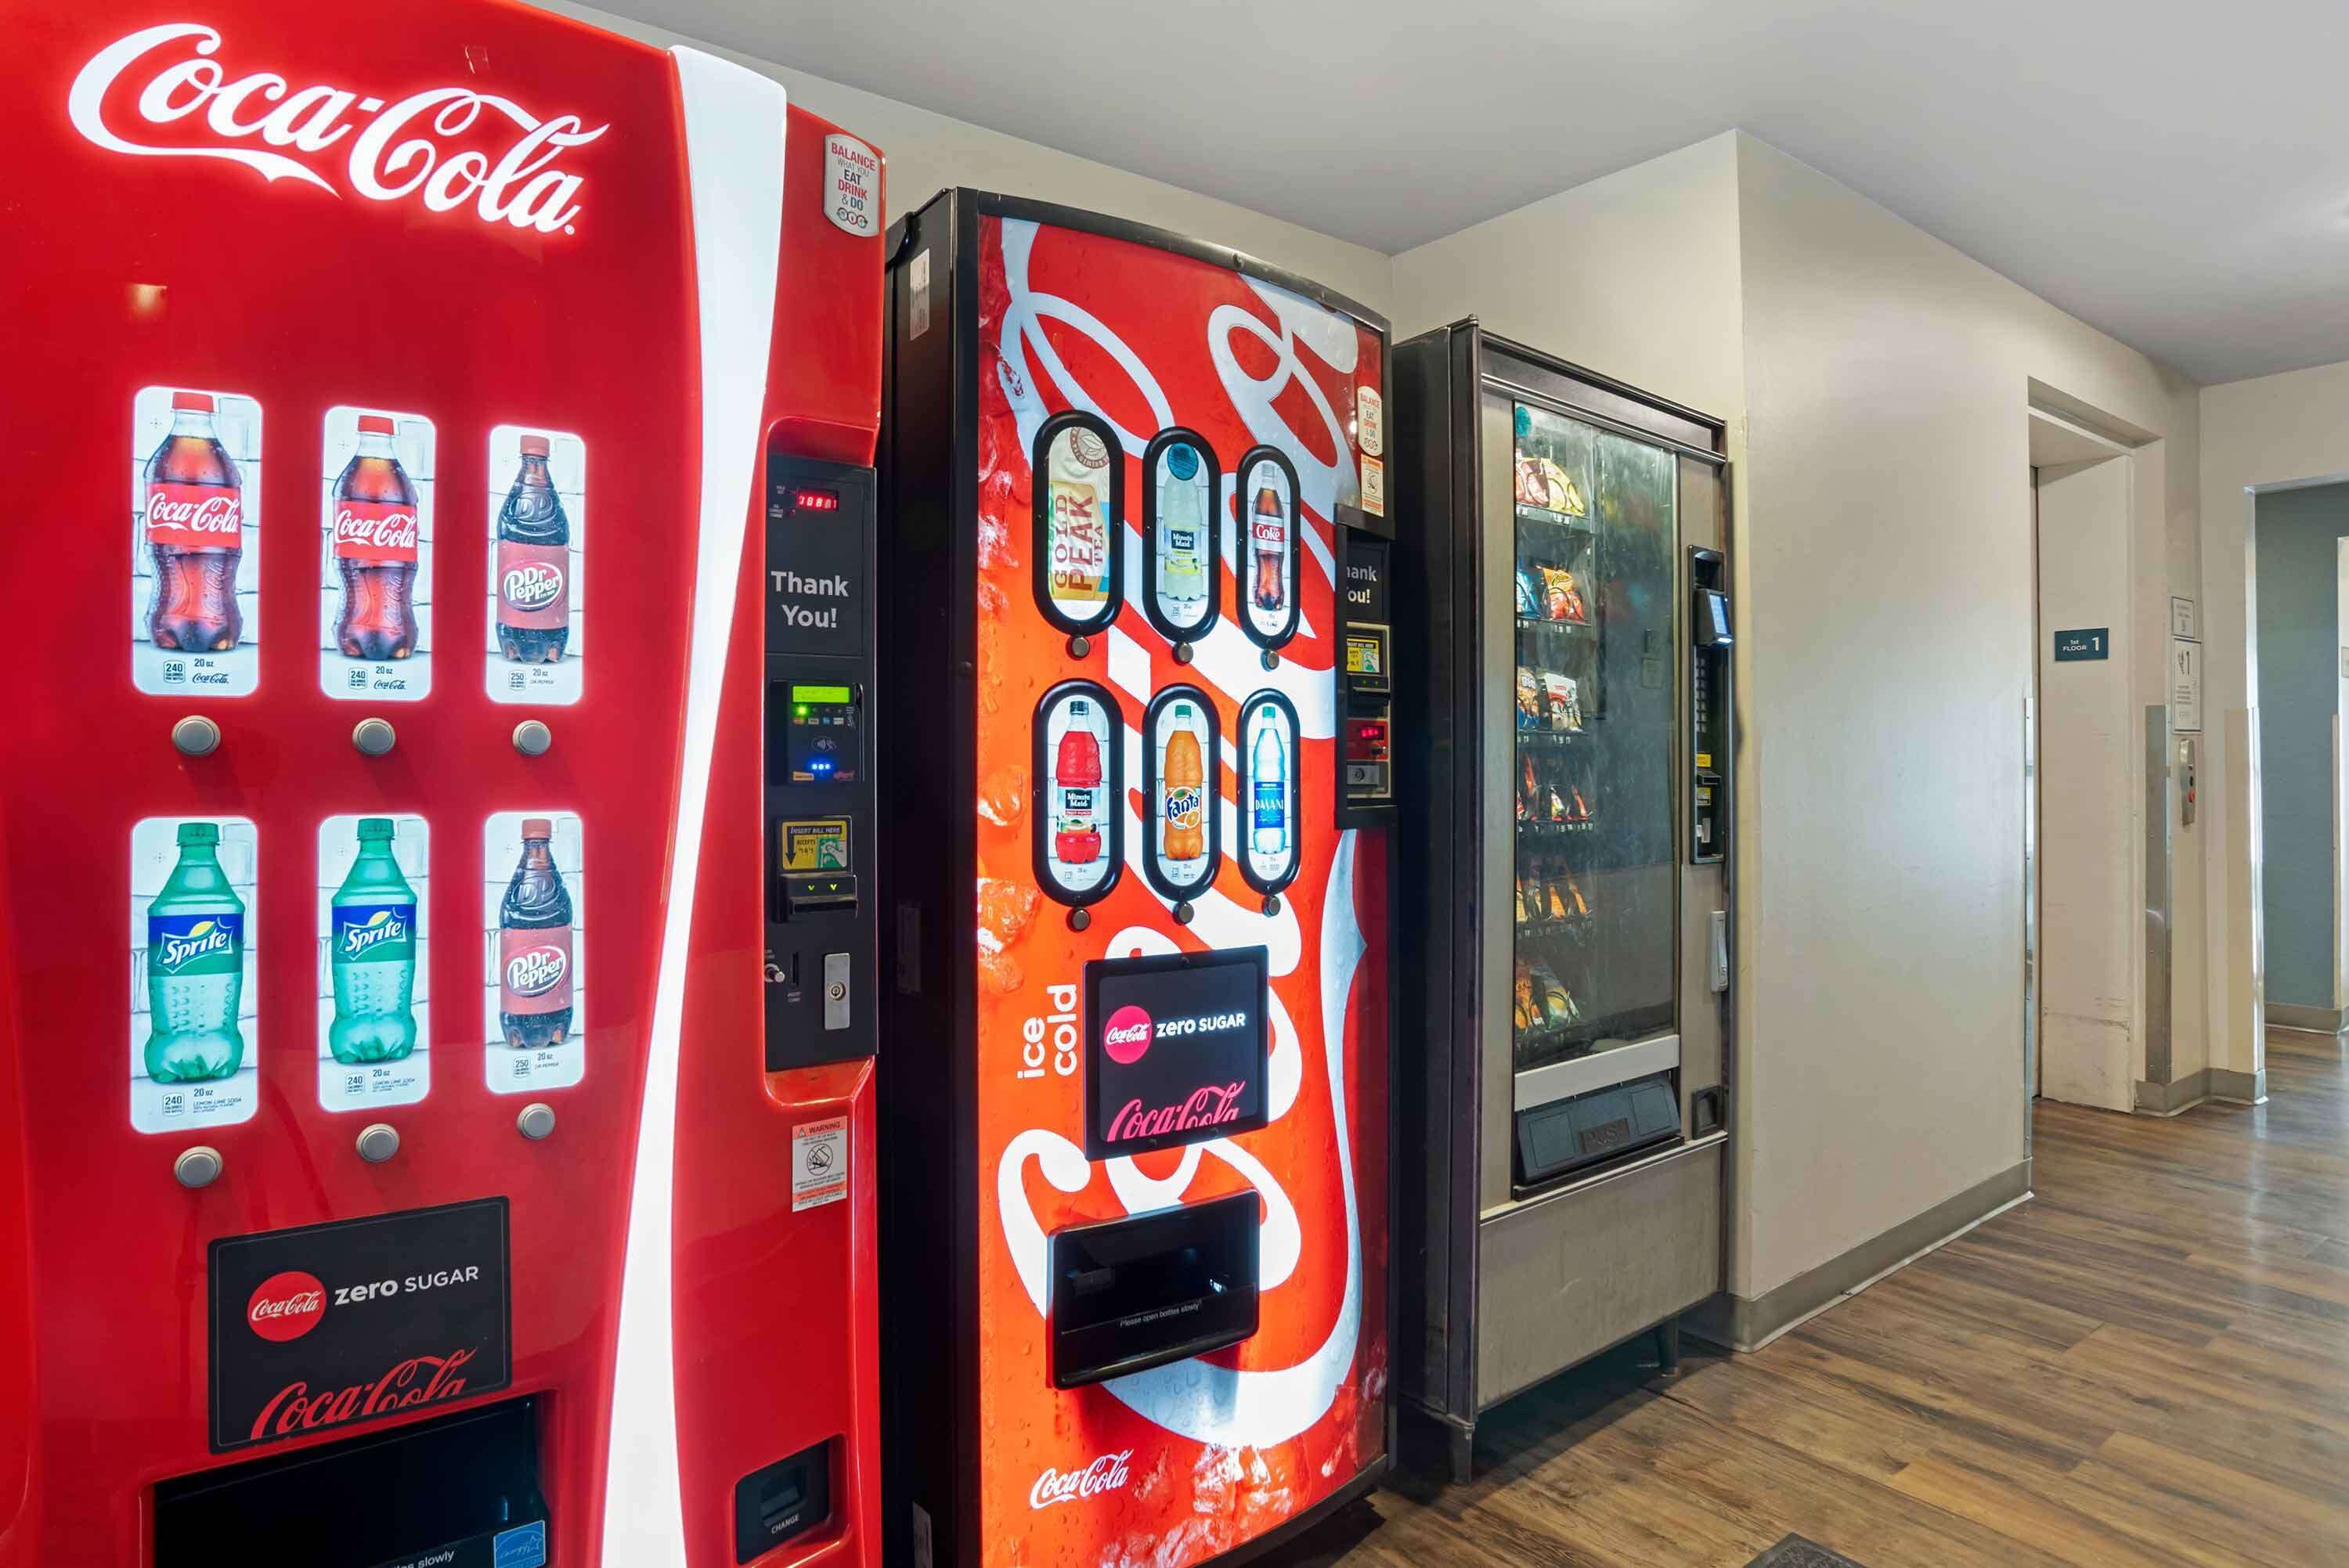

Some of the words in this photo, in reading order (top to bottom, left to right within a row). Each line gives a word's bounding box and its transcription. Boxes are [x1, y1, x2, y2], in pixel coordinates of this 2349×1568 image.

[69, 23, 609, 234] Coca-Cola
[831, 142, 876, 171] BALANCE
[837, 157, 856, 172] WHAT
[857, 165, 869, 177] YOU
[843, 169, 861, 185] EAT
[839, 178, 868, 200] DRINK
[850, 197, 864, 211] DO
[146, 492, 240, 533] Coca-Cola
[335, 510, 416, 548] Coca-Cola
[1256, 524, 1281, 540] Coke
[1055, 494, 1068, 588] GOLD
[1068, 495, 1092, 591] PEAK
[1093, 524, 1103, 567] TEA
[524, 567, 547, 584] Dr
[1347, 566, 1377, 582] ank
[510, 570, 559, 602] Pepper
[770, 571, 849, 597] Thank
[1347, 587, 1370, 604] ou!
[781, 604, 837, 628] You!
[2091, 636, 2099, 651] 1
[166, 663, 183, 672] 240
[194, 658, 204, 667] 20
[376, 665, 384, 674] 20
[193, 672, 229, 683] Coca-Cola
[351, 670, 366, 679] 240
[1167, 793, 1199, 821] Fanta
[1255, 798, 1284, 811] DASANI
[346, 919, 402, 953] Sprite
[163, 928, 227, 966] Sprite
[528, 951, 549, 970] Dr
[512, 956, 565, 989] Pepper
[1047, 984, 1077, 1076] cold
[1106, 1022, 1151, 1046] Coca-Cola
[1156, 1018, 1196, 1038] zero
[1199, 1013, 1246, 1033] SUGAR
[538, 1052, 546, 1061] 20
[1016, 1017, 1045, 1079] ice
[515, 1059, 529, 1068] 250
[348, 1076, 363, 1085] 240
[165, 1096, 182, 1105] 240
[194, 1088, 204, 1097] 20
[809, 1121, 841, 1134] WARNING
[251, 1289, 323, 1321] Coca-Cola
[334, 1278, 398, 1306] zero
[404, 1266, 479, 1292] SUGAR
[1142, 1314, 1159, 1322] open
[1181, 1303, 1200, 1313] slowly
[1030, 1448, 1134, 1509] Coca-Cola
[770, 1514, 800, 1534] CHANGE
[418, 1550, 455, 1568] slowly
